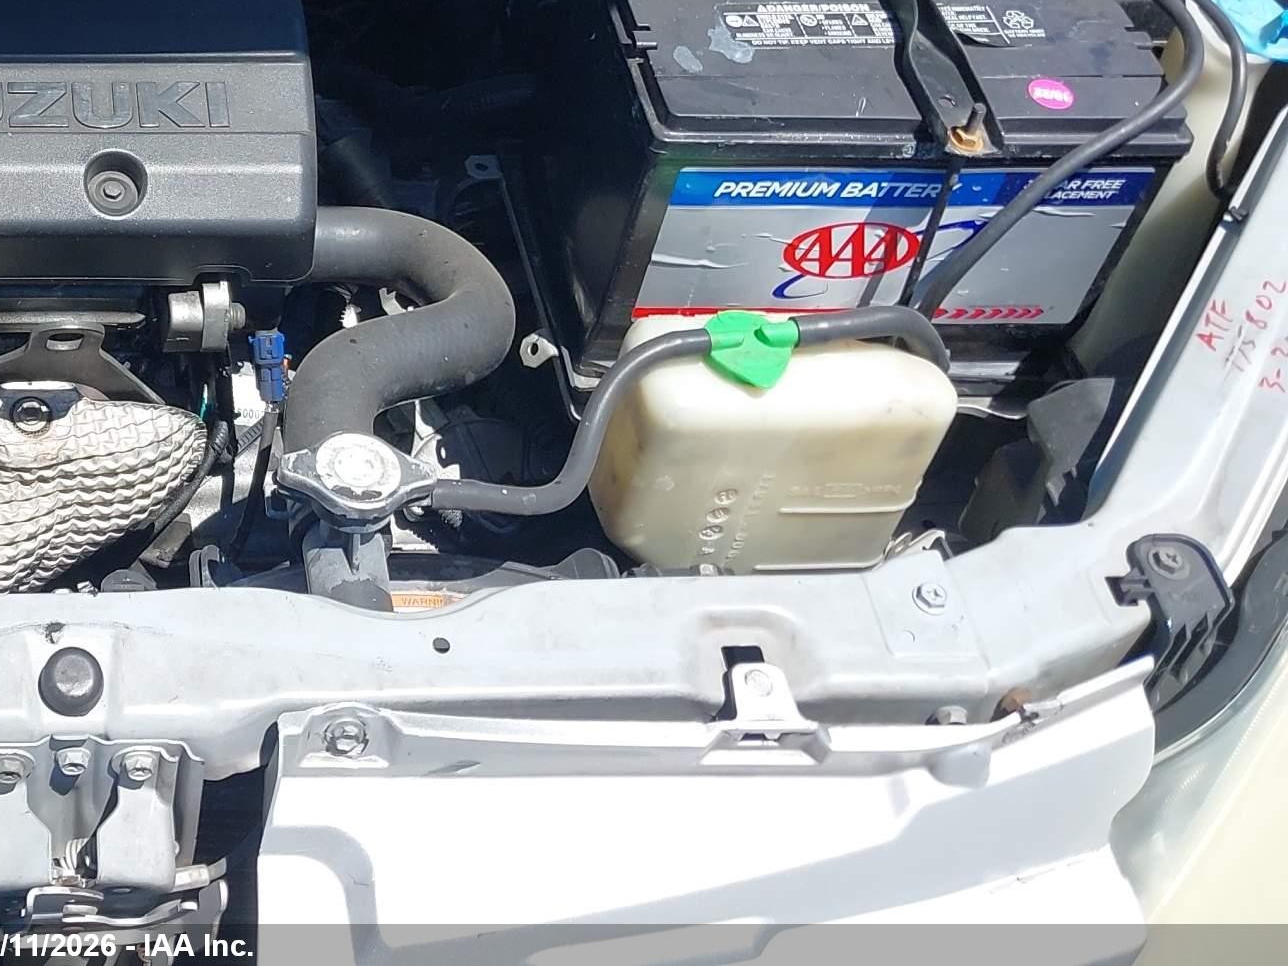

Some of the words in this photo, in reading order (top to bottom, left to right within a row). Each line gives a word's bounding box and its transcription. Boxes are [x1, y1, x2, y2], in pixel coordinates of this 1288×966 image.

[767, 3, 871, 13] DANGER/POISON
[714, 181, 838, 198] PREMIUM
[1081, 179, 1127, 190] FREE
[792, 222, 910, 278] AAA
[1196, 299, 1234, 352] ATF
